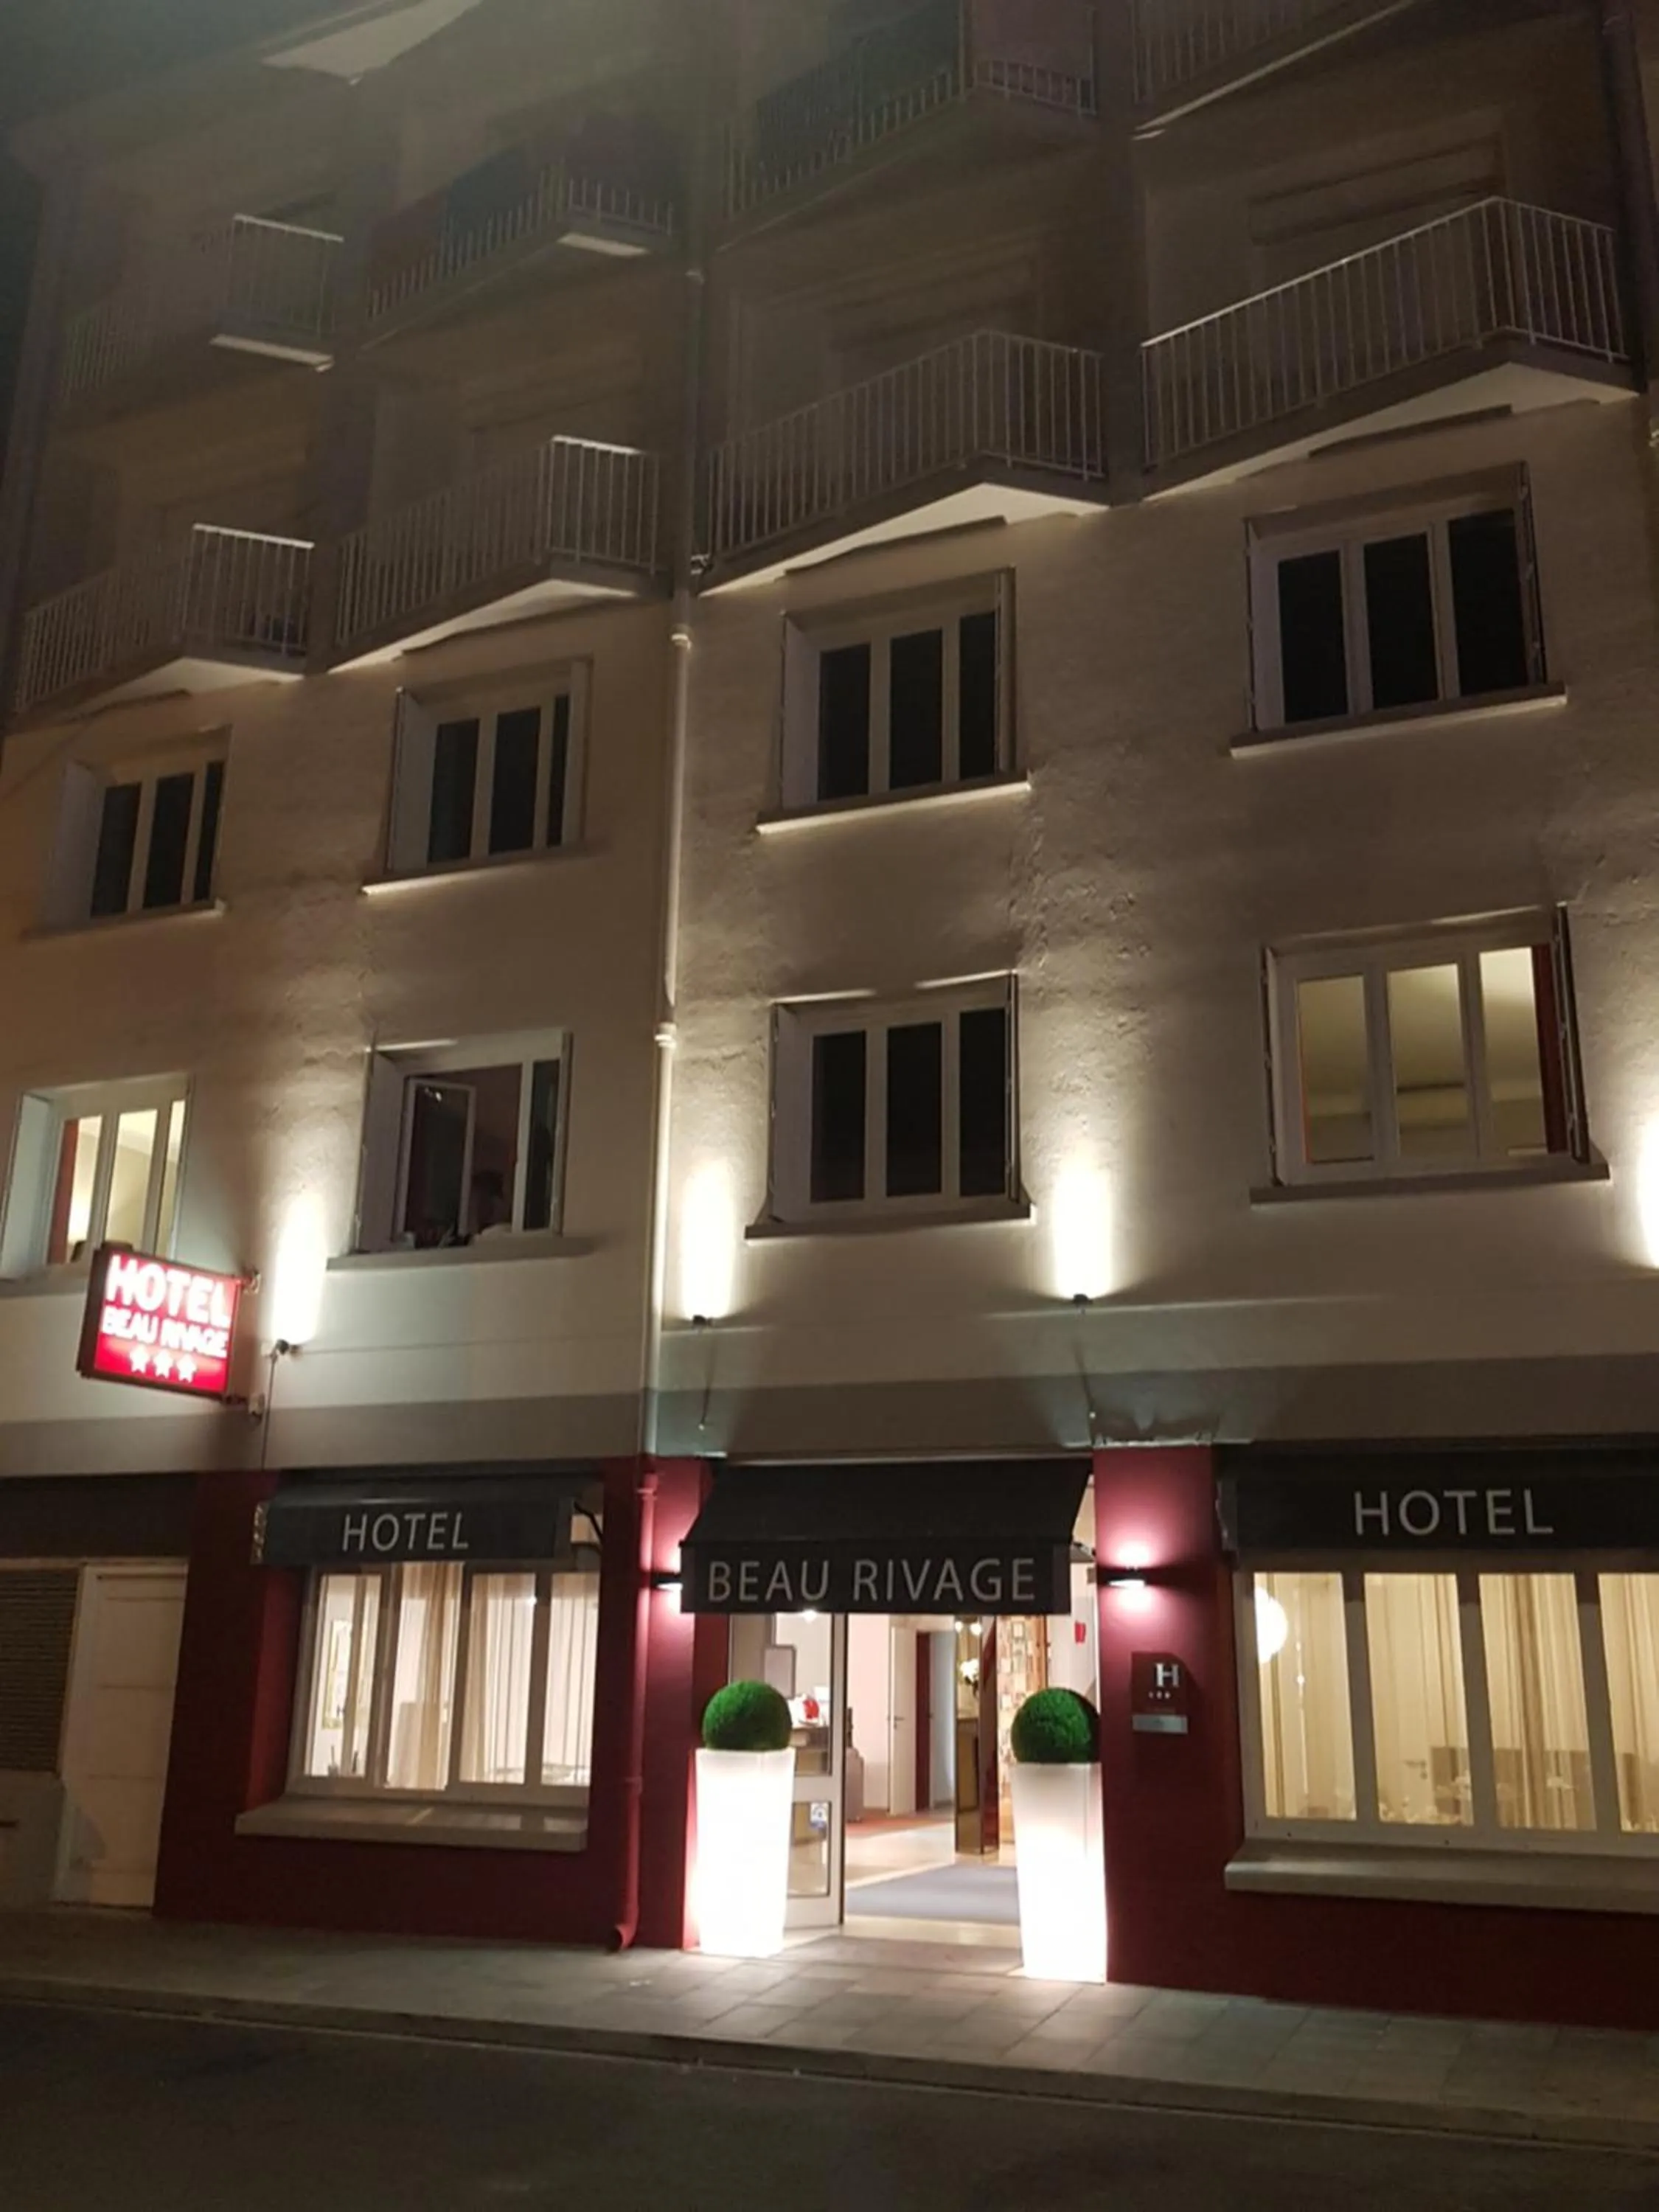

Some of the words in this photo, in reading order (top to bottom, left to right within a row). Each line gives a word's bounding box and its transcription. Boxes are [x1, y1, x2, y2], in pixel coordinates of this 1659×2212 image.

[105, 1254, 231, 1327] HOTEL
[101, 1305, 159, 1344] BEAU
[342, 1513, 469, 1551] HOTEL
[1354, 1488, 1554, 1535] HOTEL
[709, 1560, 830, 1601] BEAU
[852, 1558, 1036, 1601] RIVAGE
[1156, 1663, 1179, 1687] H
